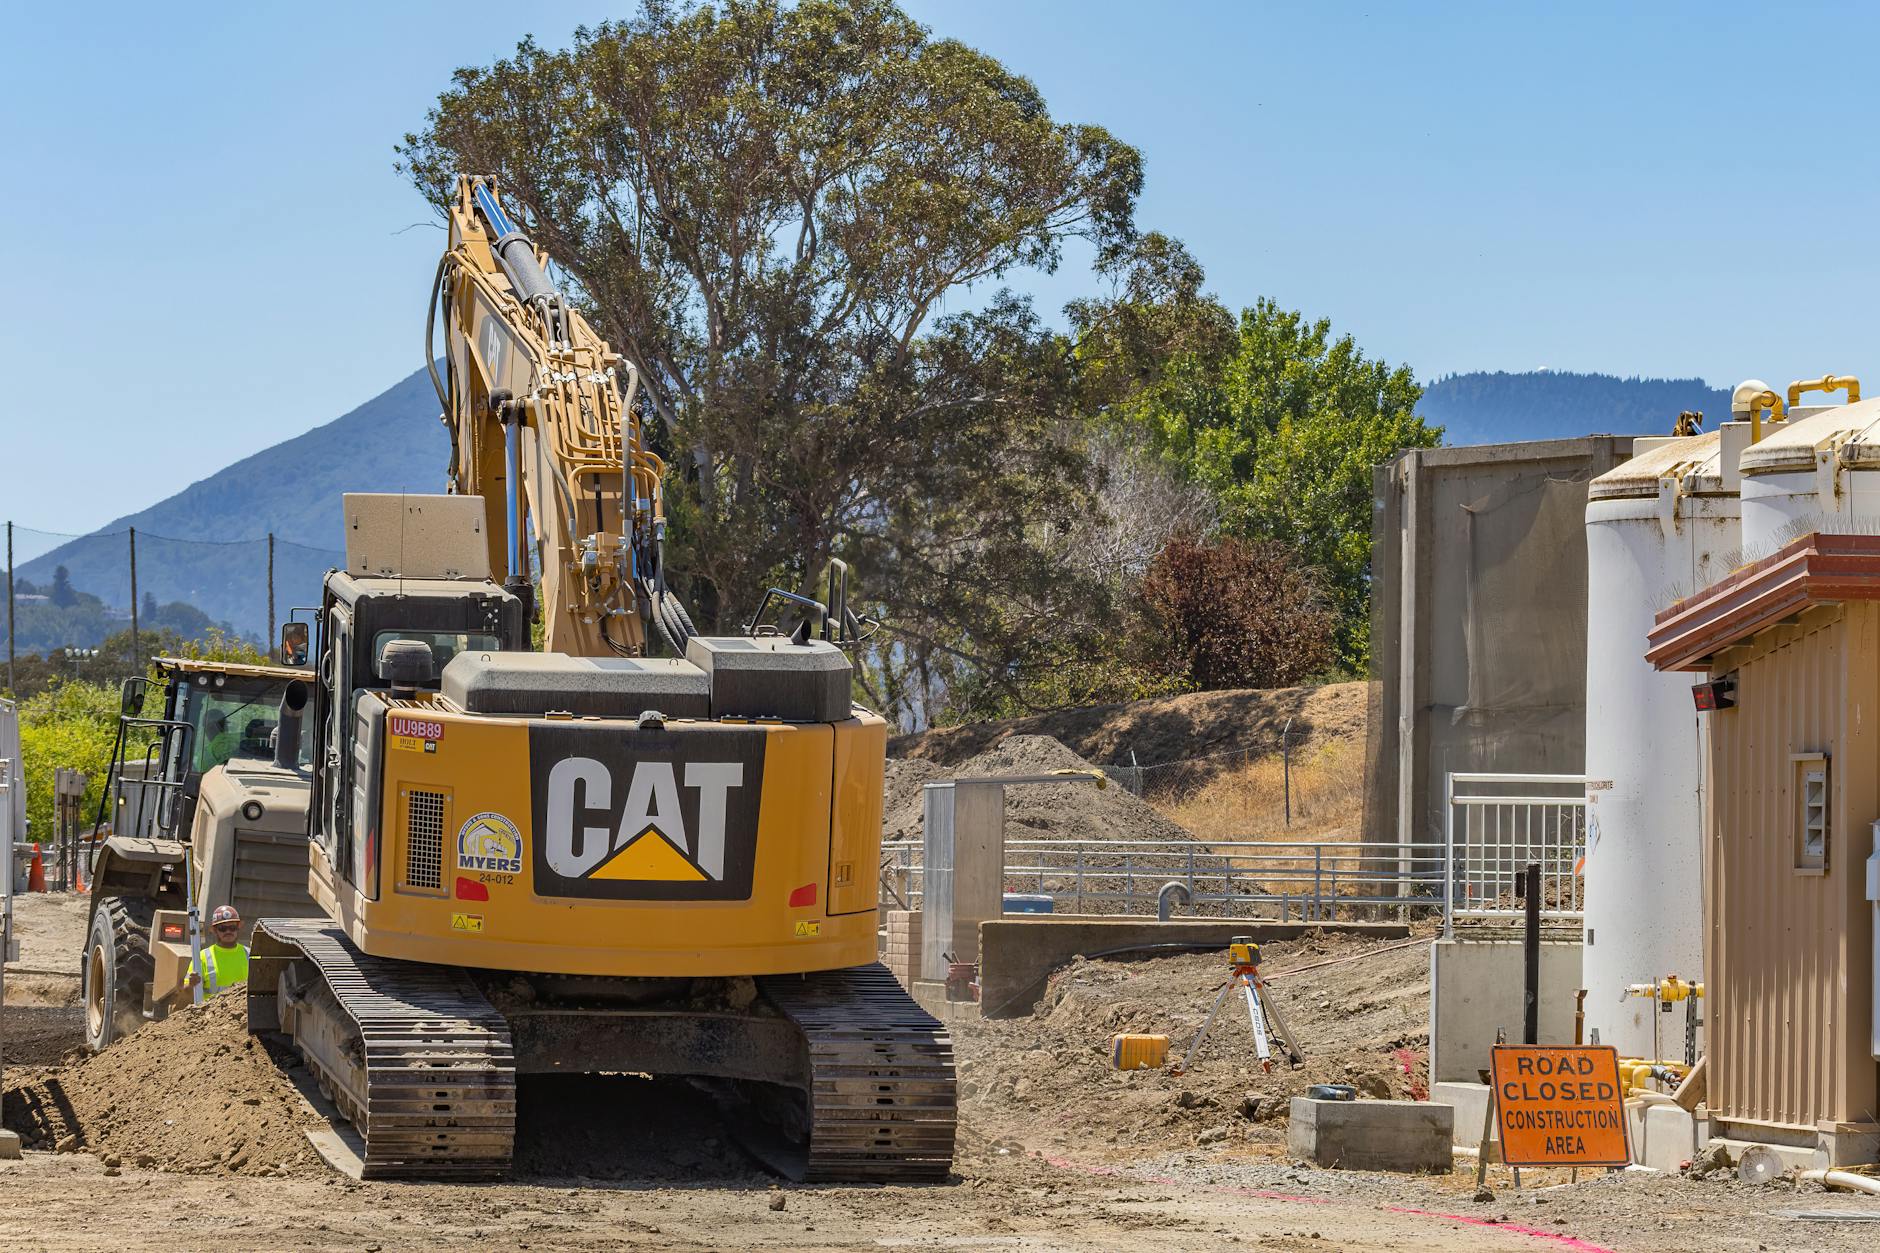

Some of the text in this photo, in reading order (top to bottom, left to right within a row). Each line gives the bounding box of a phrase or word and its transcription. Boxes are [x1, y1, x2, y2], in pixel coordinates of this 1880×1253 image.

[393, 718, 442, 738] UU9B89
[425, 743, 435, 751] CAT
[545, 757, 744, 881] CAT
[459, 855, 521, 872] MYERS
[479, 873, 514, 885] 24-012
[1517, 1056, 1594, 1076] ROAD
[1503, 1082, 1614, 1101] CLOSED
[1505, 1108, 1619, 1130] CONSTRUCTION
[1545, 1136, 1587, 1155] AREA
